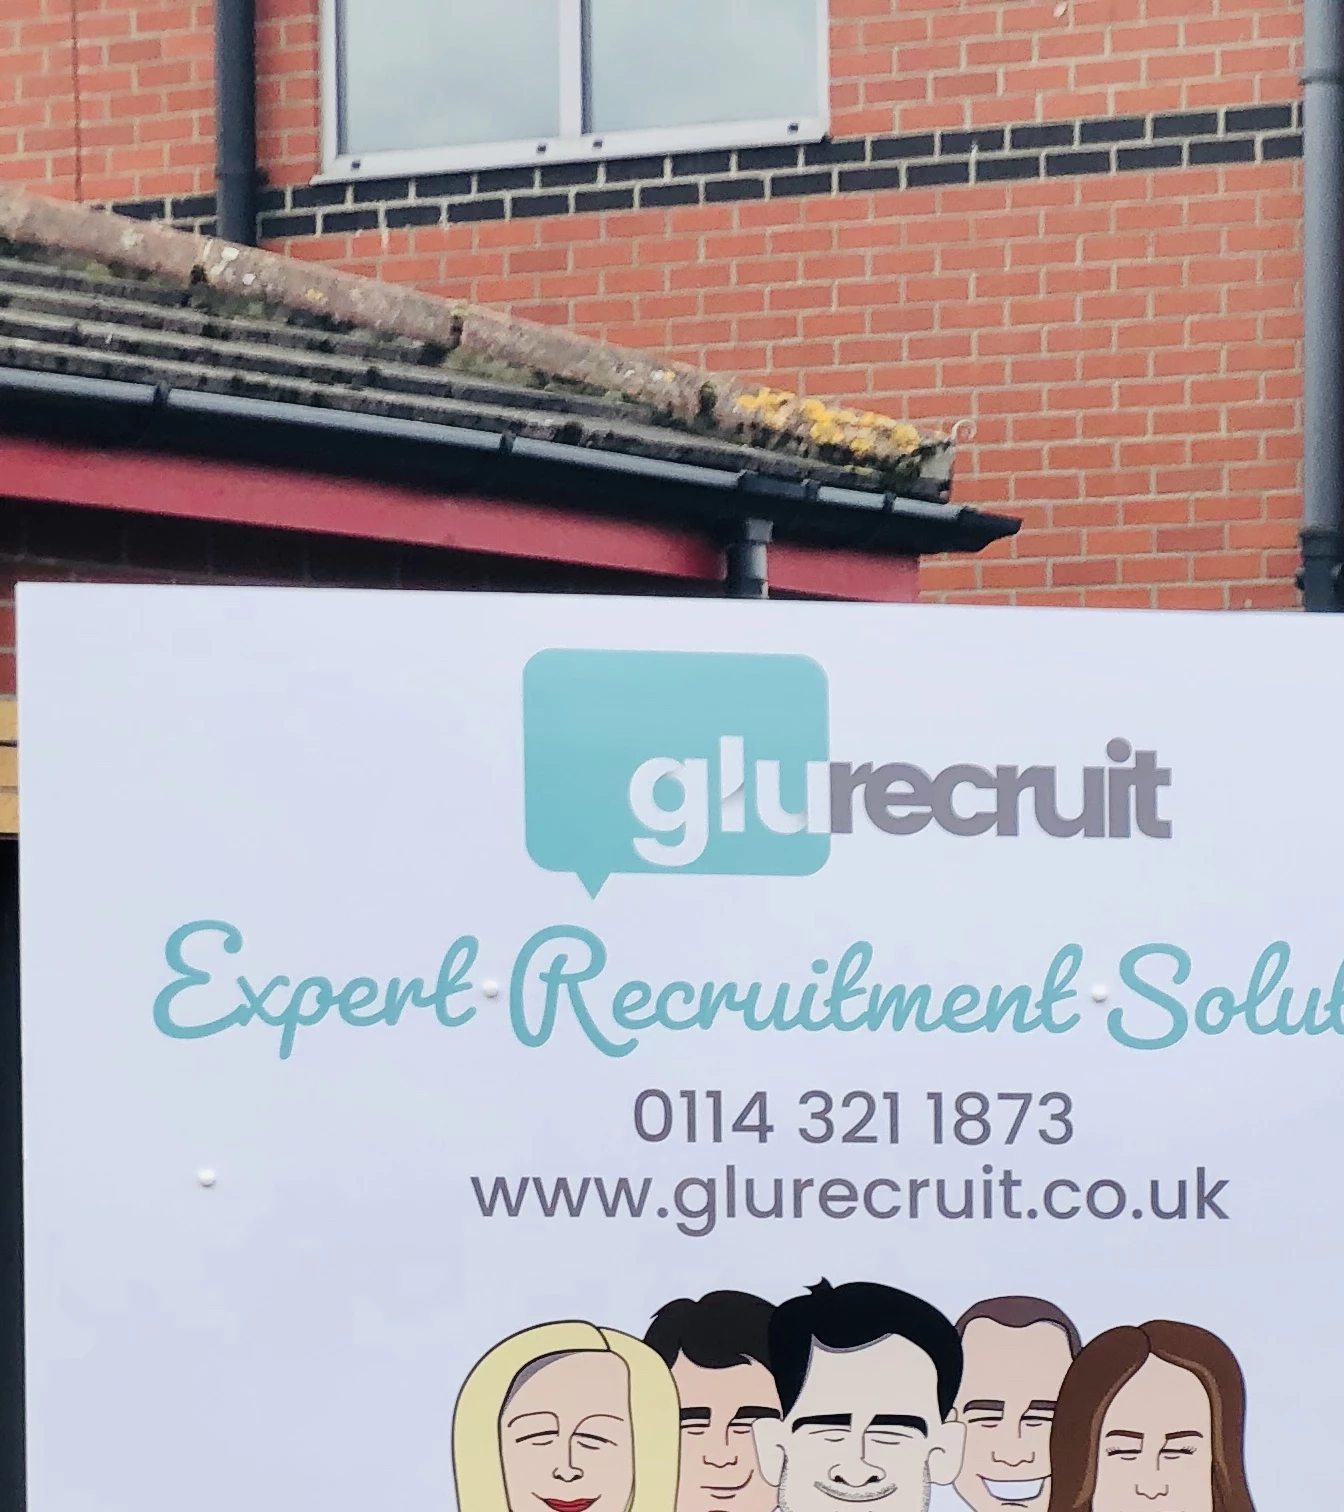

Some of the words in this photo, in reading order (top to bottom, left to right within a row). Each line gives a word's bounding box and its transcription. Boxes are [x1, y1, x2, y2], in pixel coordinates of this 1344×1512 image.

[628, 735, 1172, 867] glurecruit
[151, 918, 480, 1062] Expert
[508, 923, 1084, 1060] Recruitment
[633, 1088, 774, 1144] 0114
[798, 1089, 899, 1145] 321
[926, 1091, 1074, 1146] 1873
[470, 1164, 1230, 1238] www.glurecruit.co.uk
